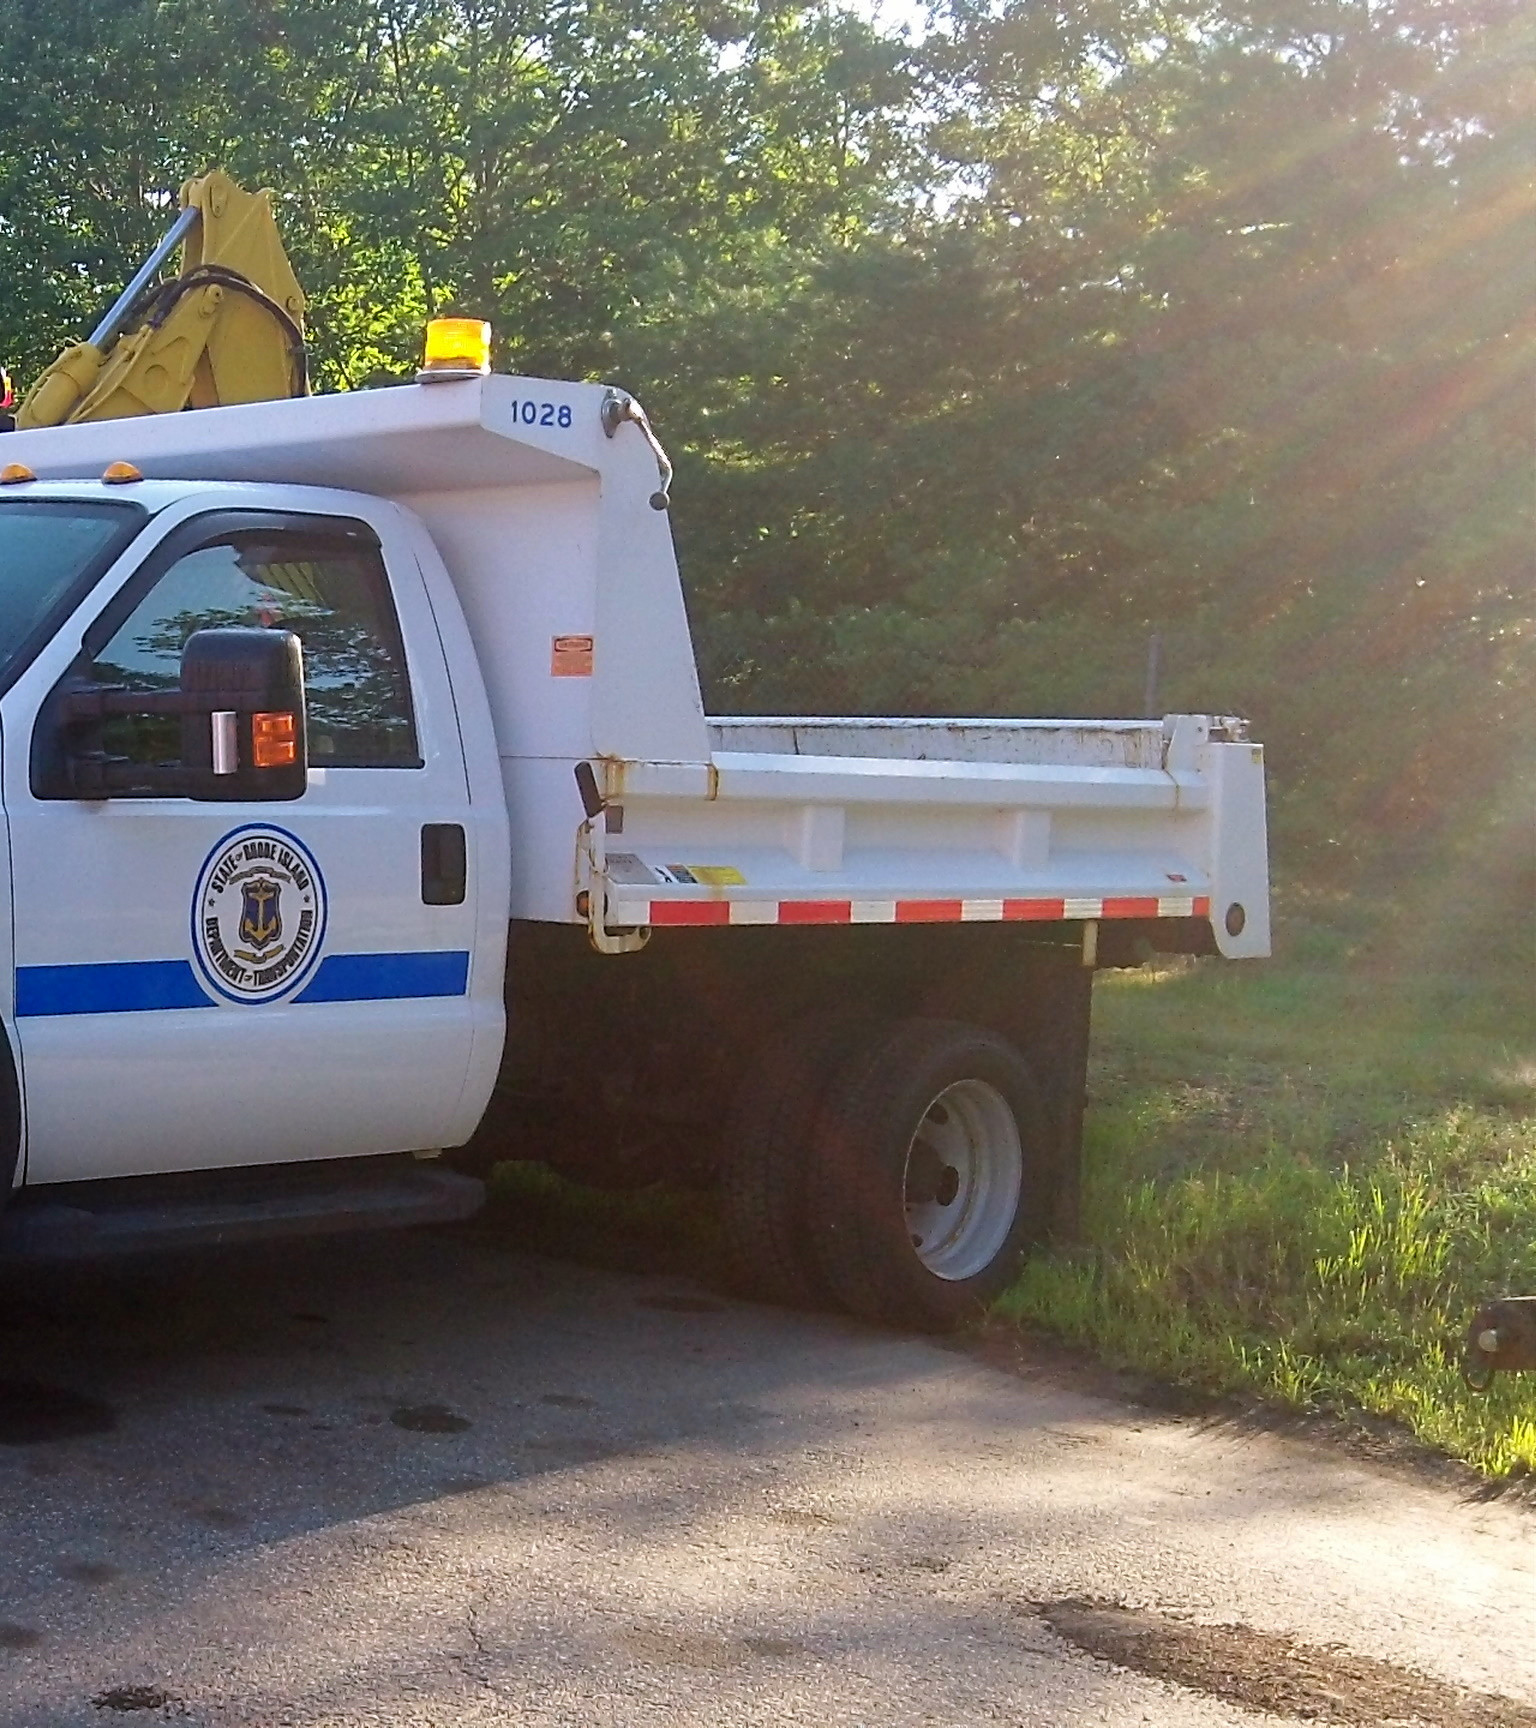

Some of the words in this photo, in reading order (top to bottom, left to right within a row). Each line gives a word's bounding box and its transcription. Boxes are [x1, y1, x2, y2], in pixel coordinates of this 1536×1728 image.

[511, 400, 572, 428] 1028
[211, 855, 239, 894] STATE
[243, 841, 277, 861] RHODE
[277, 847, 310, 891] ISLAND
